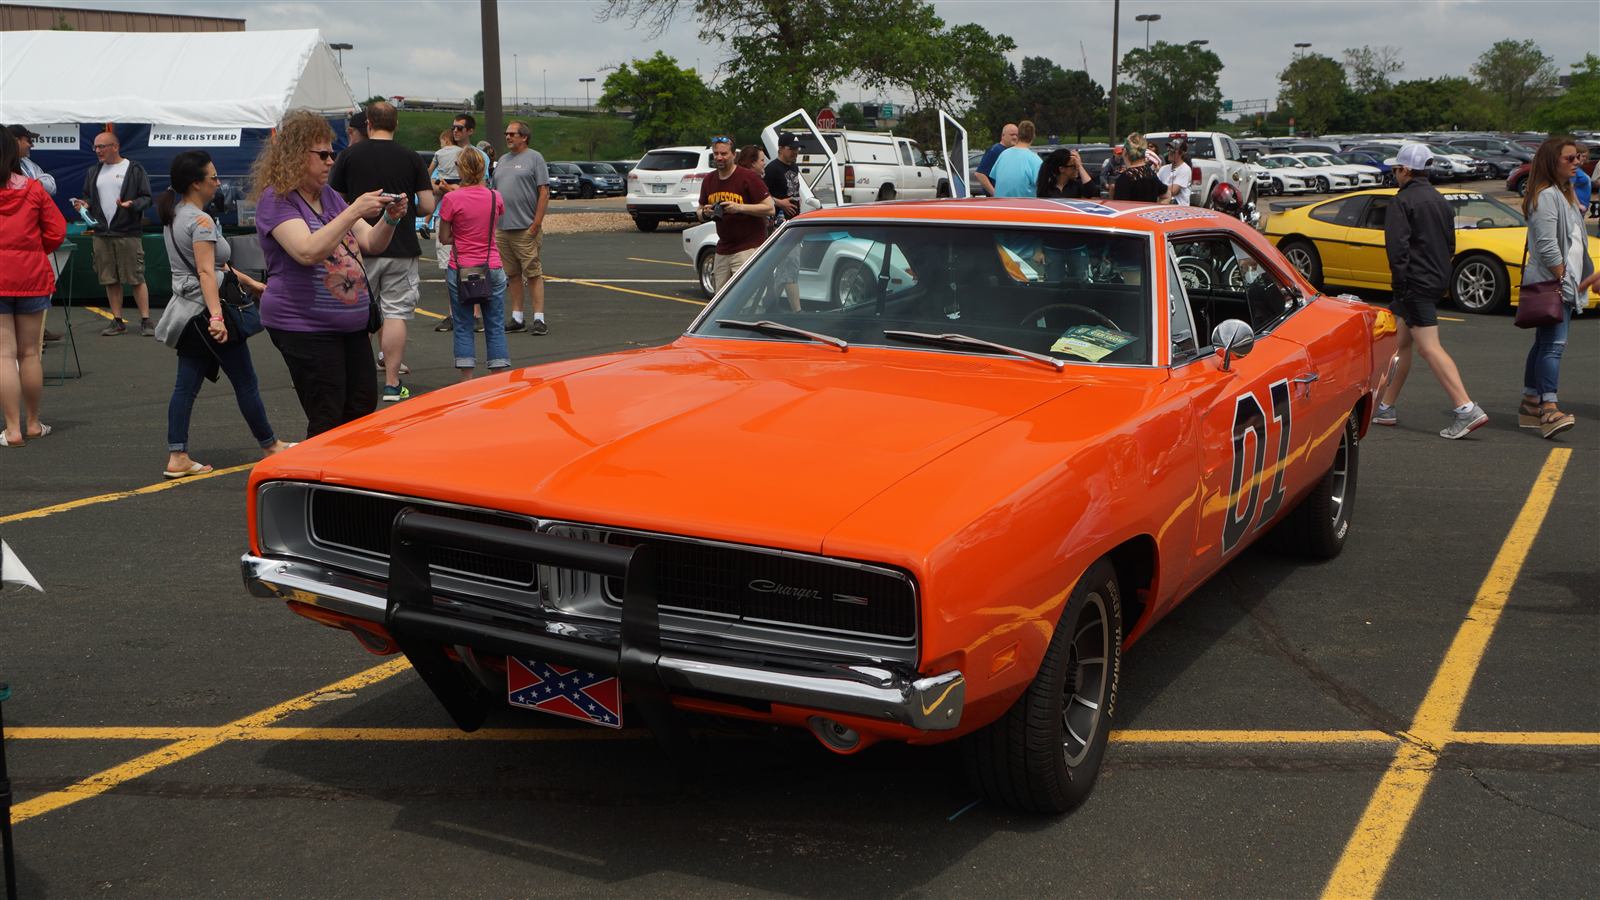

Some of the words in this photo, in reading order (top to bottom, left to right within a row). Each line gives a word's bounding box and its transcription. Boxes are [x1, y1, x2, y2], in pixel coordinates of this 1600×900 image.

[818, 119, 834, 129] STOP
[153, 133, 238, 141] PRE-REGISTERED
[1222, 378, 1292, 556] 01
[748, 579, 823, 601] Charger
[1107, 626, 1121, 718] THOMPSON
